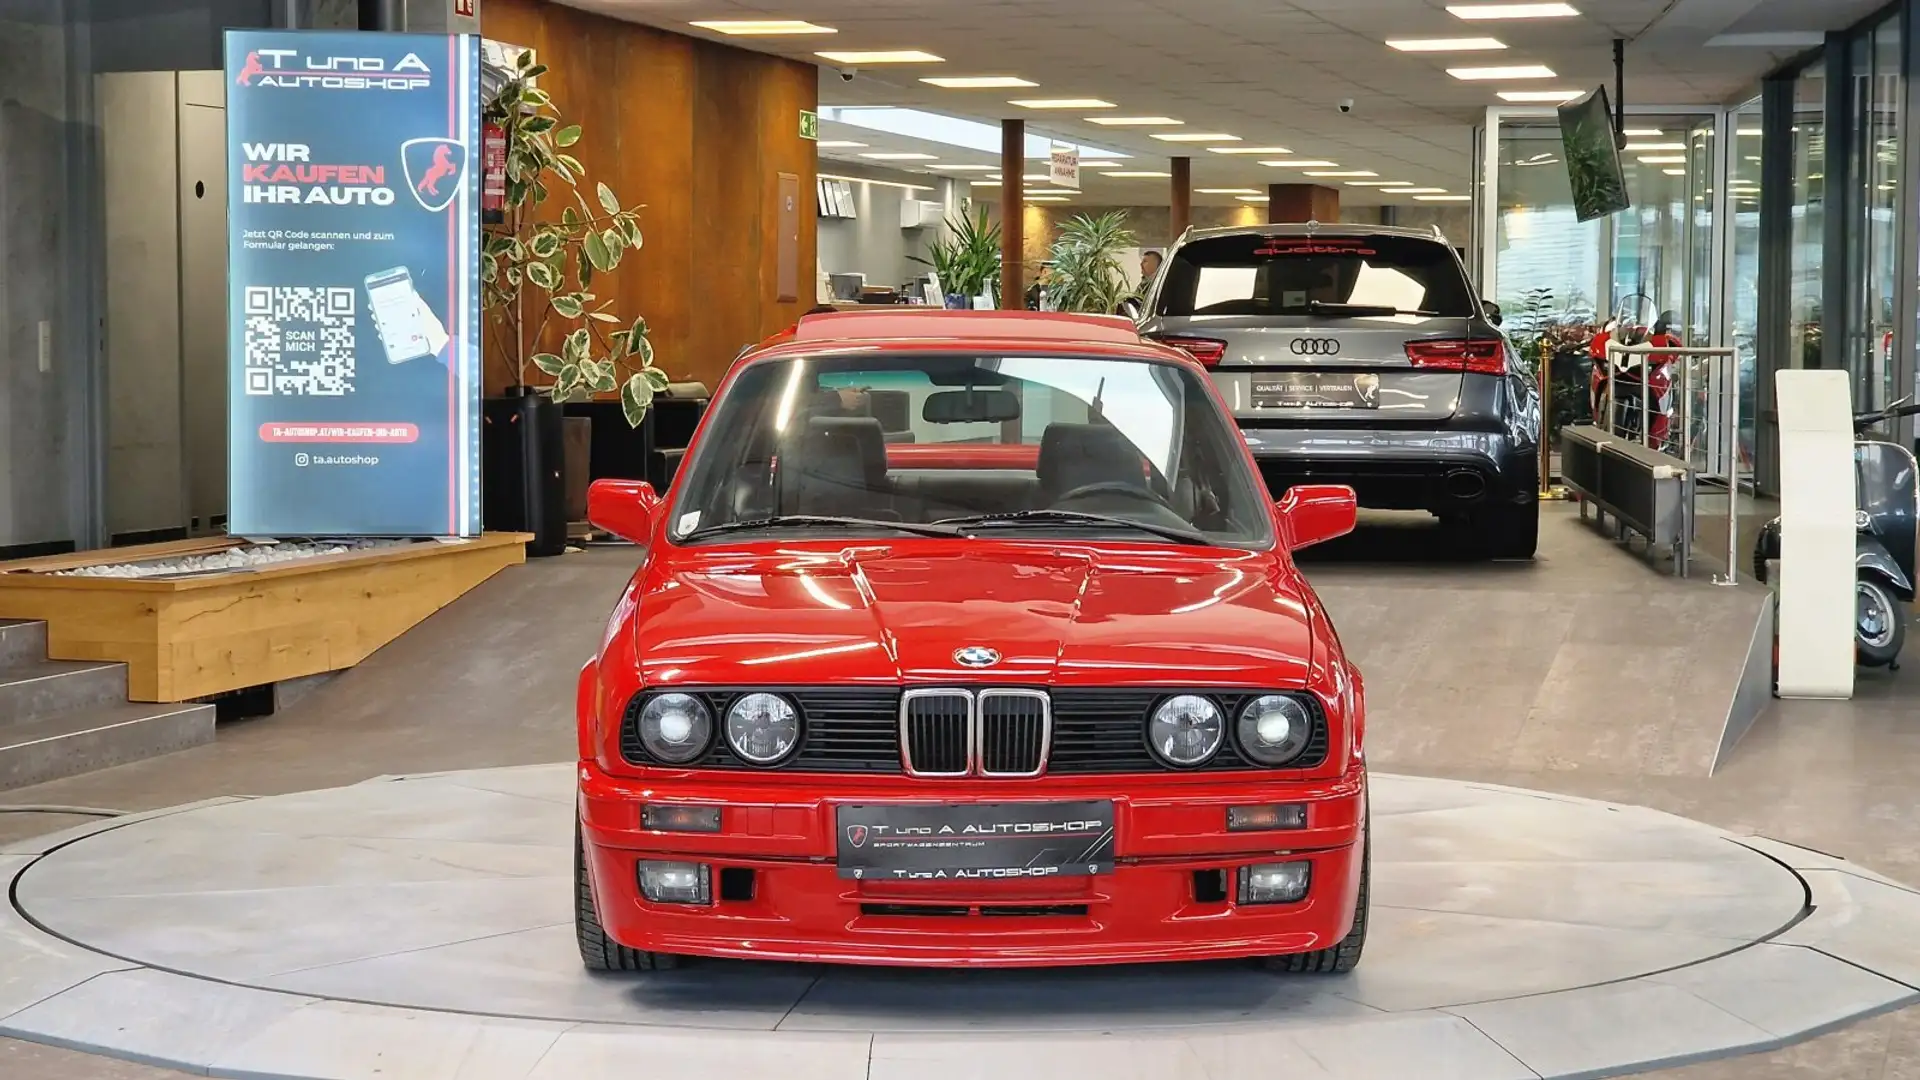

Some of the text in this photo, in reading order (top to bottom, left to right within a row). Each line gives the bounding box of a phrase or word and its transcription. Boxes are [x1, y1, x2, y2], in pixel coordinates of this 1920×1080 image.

[258, 49, 297, 69] T
[392, 53, 431, 72] A
[257, 76, 430, 90] AUTOSHOP
[241, 142, 310, 162] WIR
[243, 163, 385, 184] KAUFEN
[243, 184, 395, 206] IHR AUTO
[243, 229, 395, 240] Jetzt QR Code scannen und zum
[243, 241, 335, 252] Formular gelangen:
[285, 331, 316, 341] SCAN
[285, 341, 316, 352] MICH
[313, 455, 379, 466] ta.autoshop
[872, 825, 889, 834] T
[938, 825, 955, 834] A
[962, 820, 1102, 834] AUTOSHOP
[955, 866, 1058, 878] AUTOSHOP
